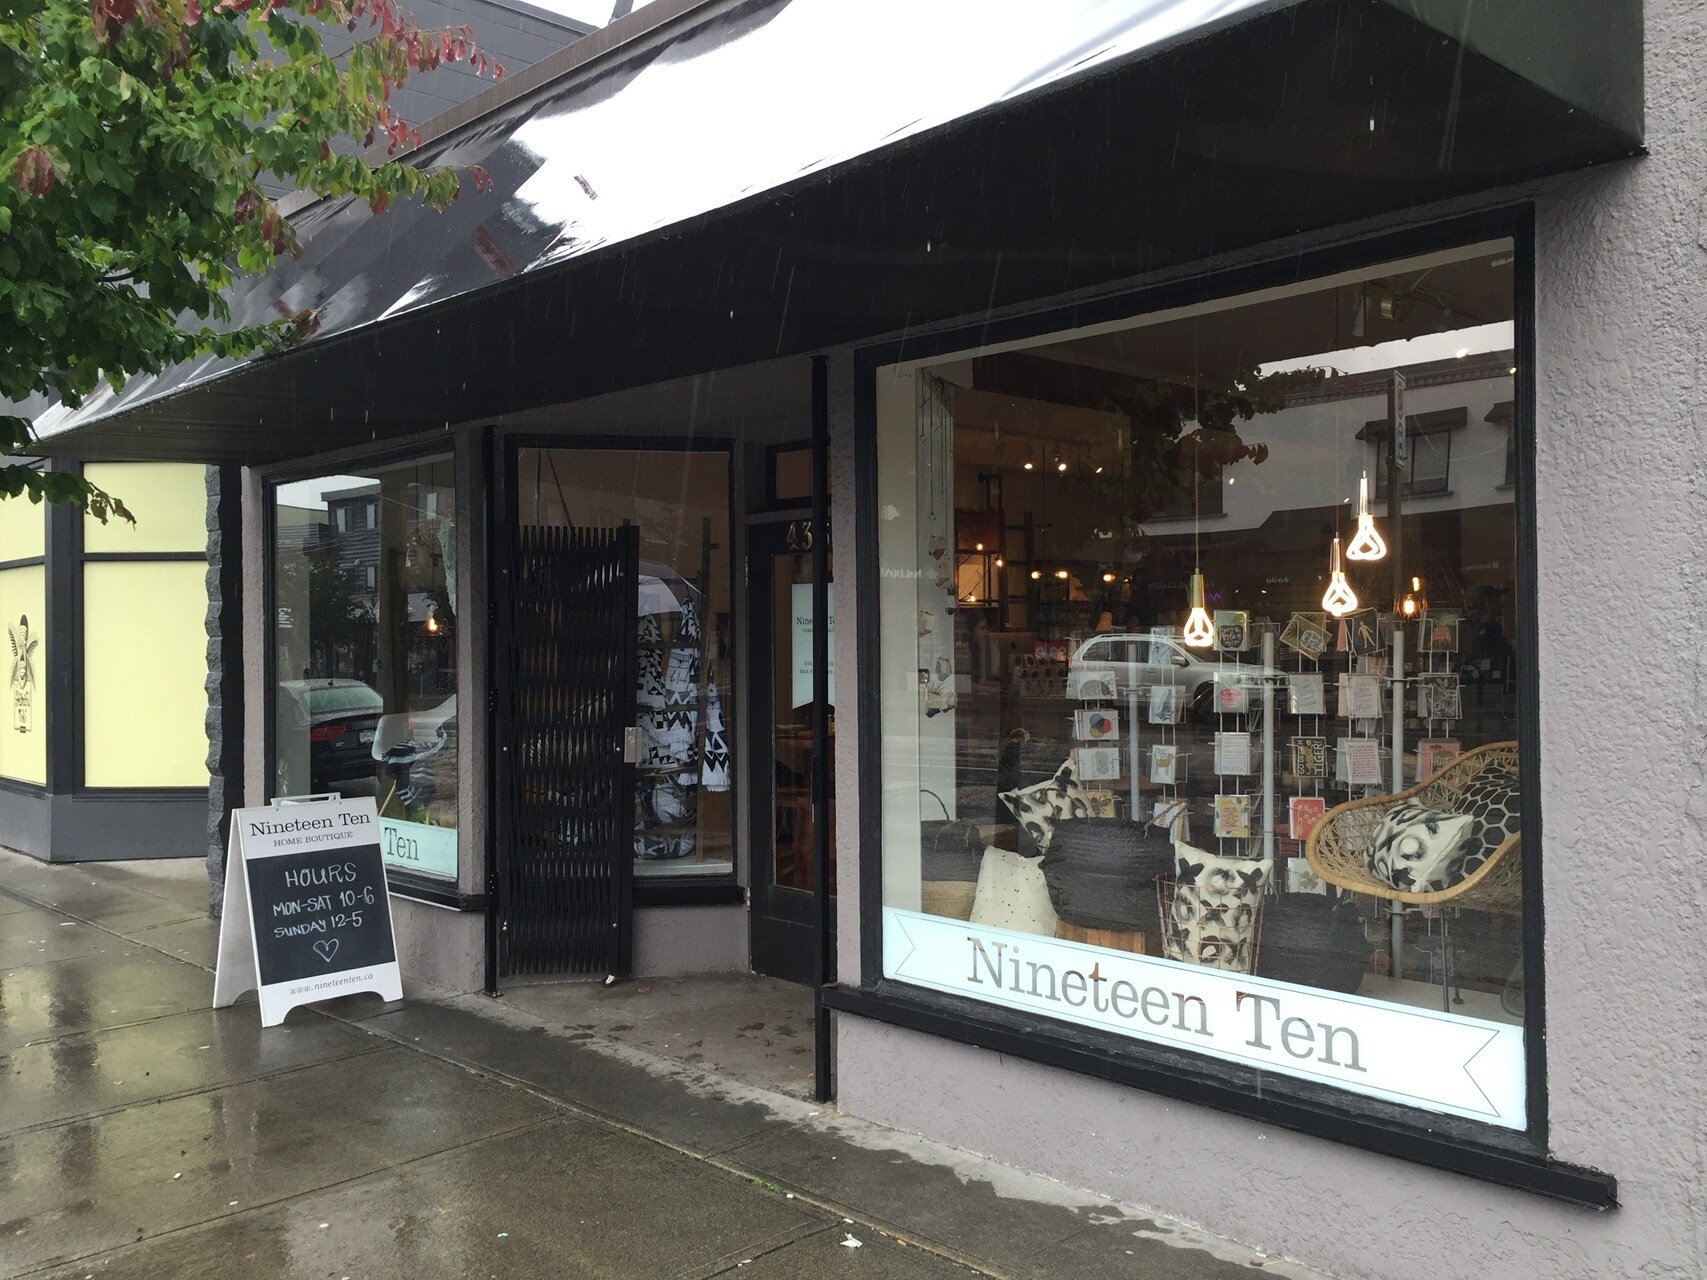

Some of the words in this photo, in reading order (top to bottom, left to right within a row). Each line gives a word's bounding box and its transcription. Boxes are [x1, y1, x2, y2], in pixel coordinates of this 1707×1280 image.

[785, 521, 813, 550] 43
[249, 817, 334, 837] Nineteen
[338, 812, 371, 826] Ten
[273, 837, 303, 847] HOME
[305, 831, 354, 843] BOUTIQUE
[384, 826, 420, 861] Ten
[285, 861, 357, 888] HOURS
[272, 894, 332, 917] MON-SAT
[339, 885, 375, 907] 10-6
[273, 919, 327, 938] SUNDAY
[330, 910, 363, 929] 12-5
[289, 973, 374, 995] www.nineteenten.ca
[966, 936, 1214, 1038] Nineteen
[1236, 990, 1368, 1073] Ten
